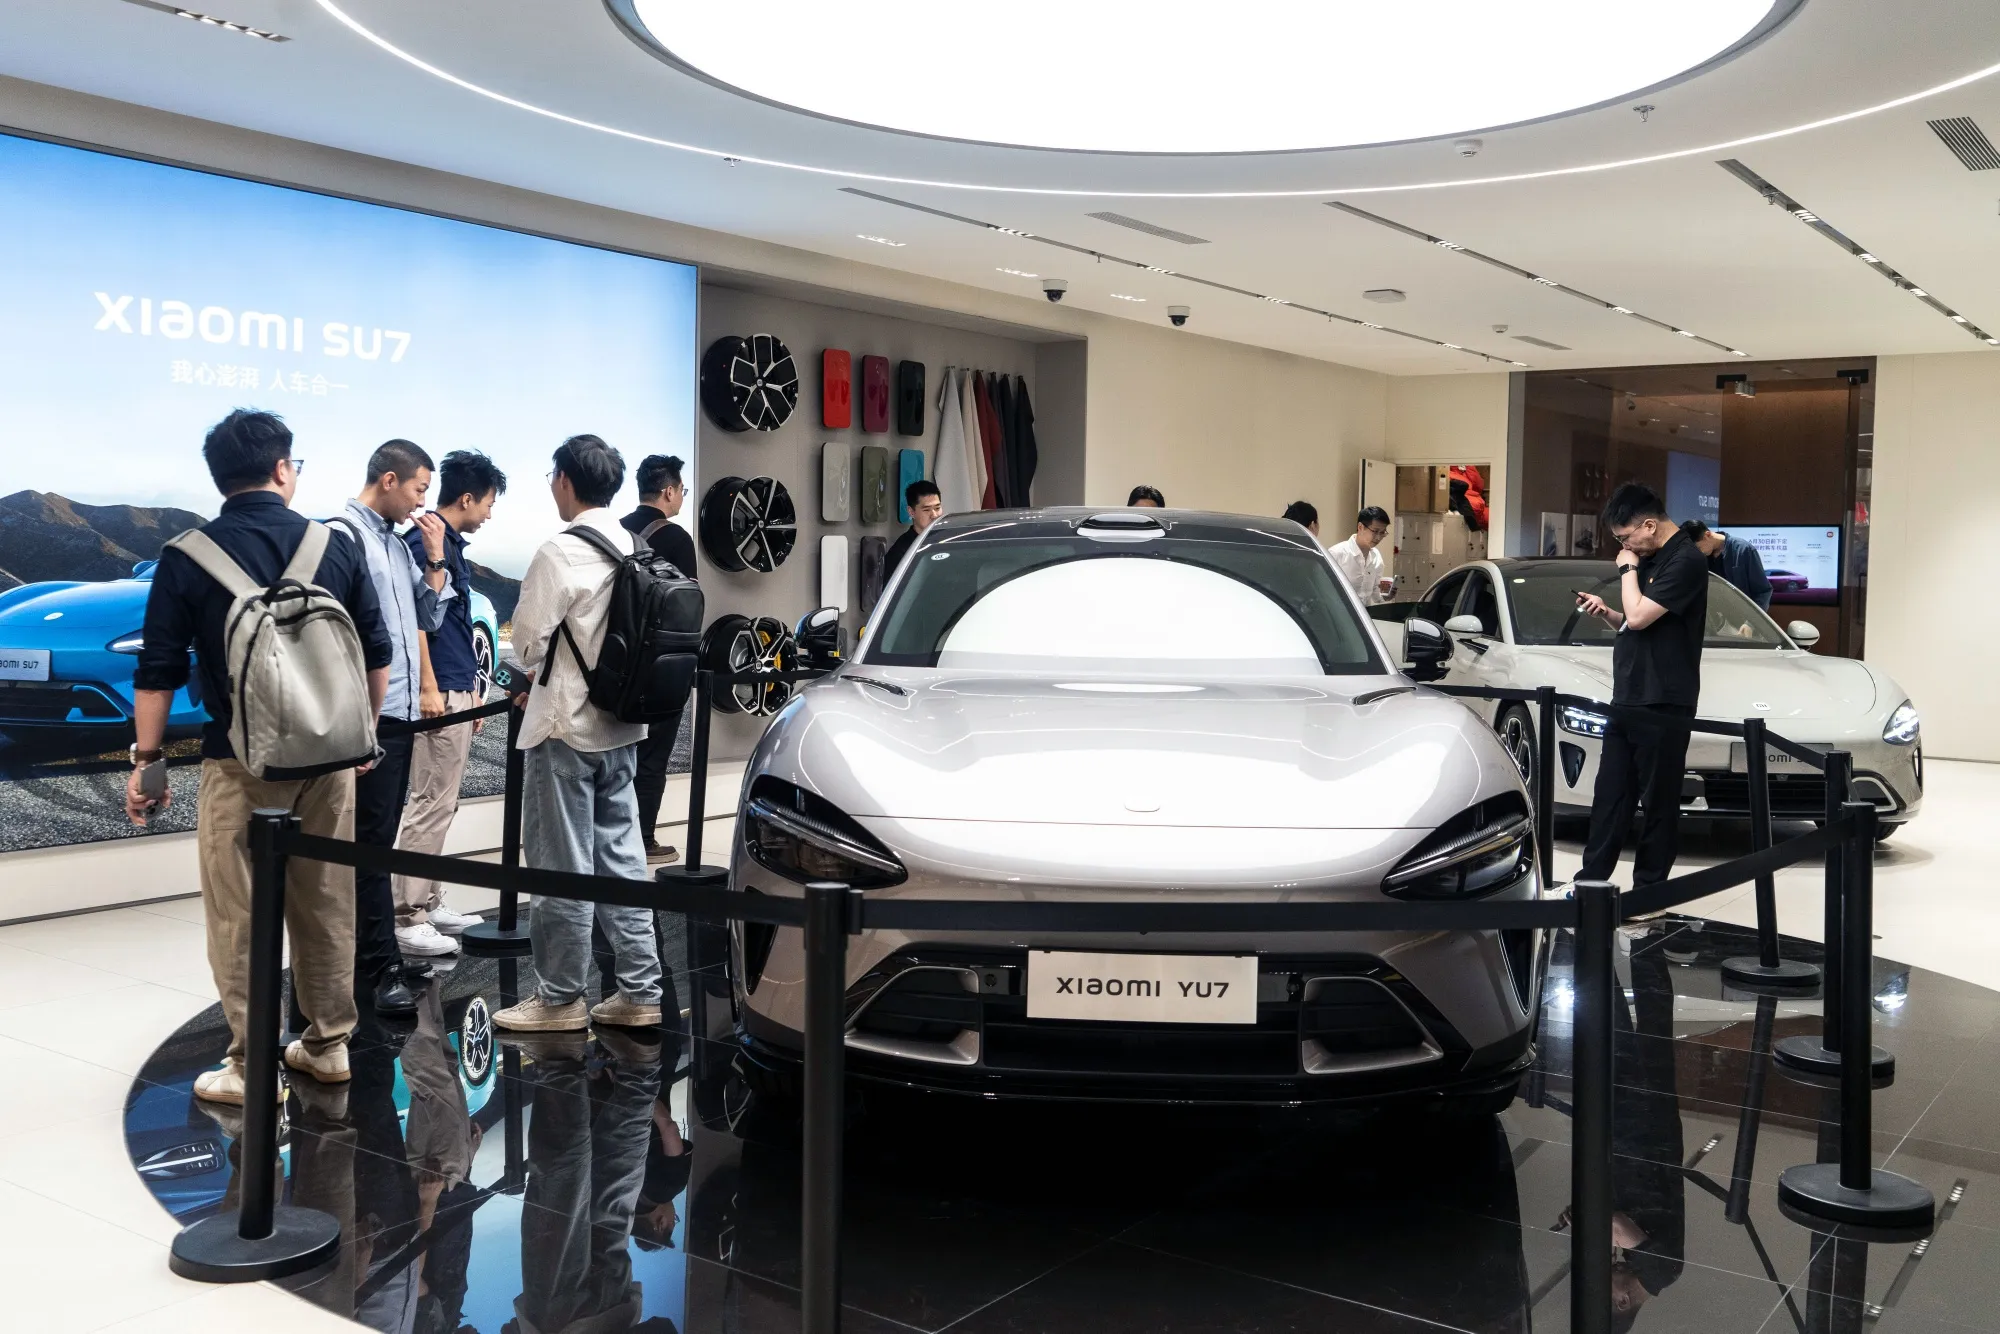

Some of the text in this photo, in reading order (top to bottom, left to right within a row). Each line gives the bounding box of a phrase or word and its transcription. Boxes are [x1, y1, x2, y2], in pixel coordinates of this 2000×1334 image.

[322, 322, 412, 363] SU7
[171, 359, 350, 396] 我心澎湃 人车合一
[22, 660, 39, 669] SU7
[1177, 981, 1230, 998] YU7
